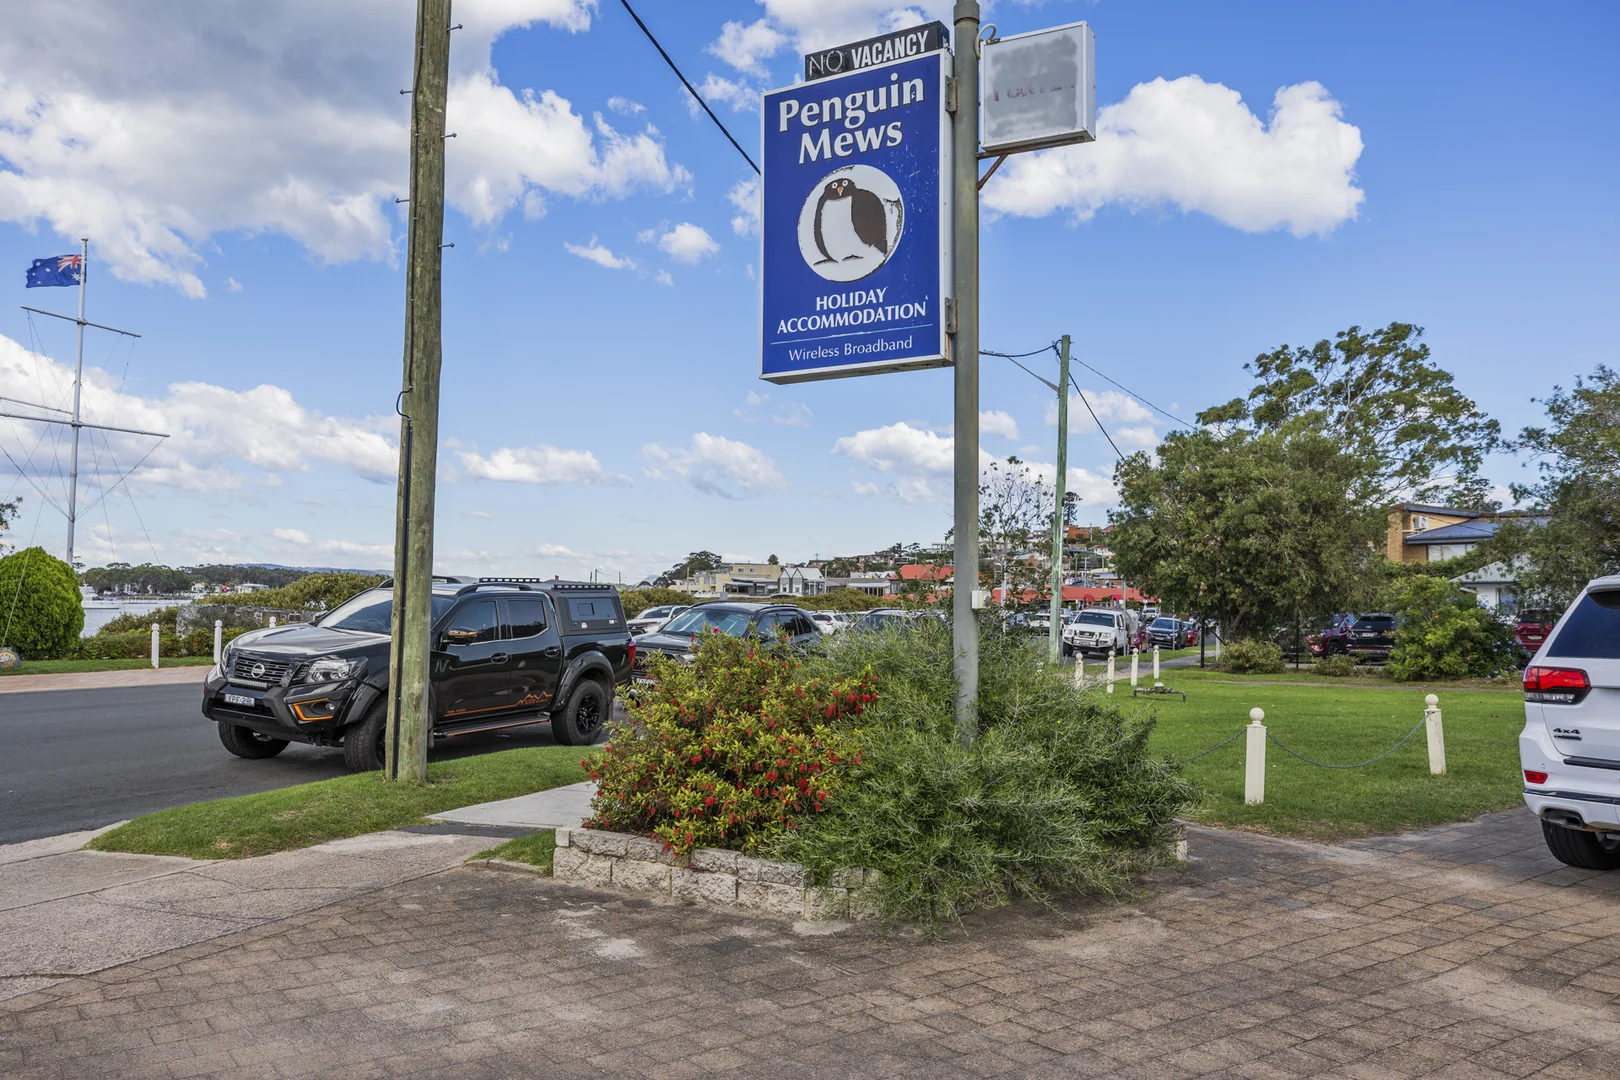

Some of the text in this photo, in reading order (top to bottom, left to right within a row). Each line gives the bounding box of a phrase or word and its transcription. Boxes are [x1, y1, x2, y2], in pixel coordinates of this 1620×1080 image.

[808, 30, 928, 77] NO VACANCY
[779, 72, 924, 132] Penguin
[799, 121, 903, 164] Mews
[816, 286, 888, 311] HOLIDAY
[777, 302, 926, 334] ACCOMMODATION
[789, 335, 913, 361] Wireless Broadband
[1553, 727, 1581, 735] 4x4
